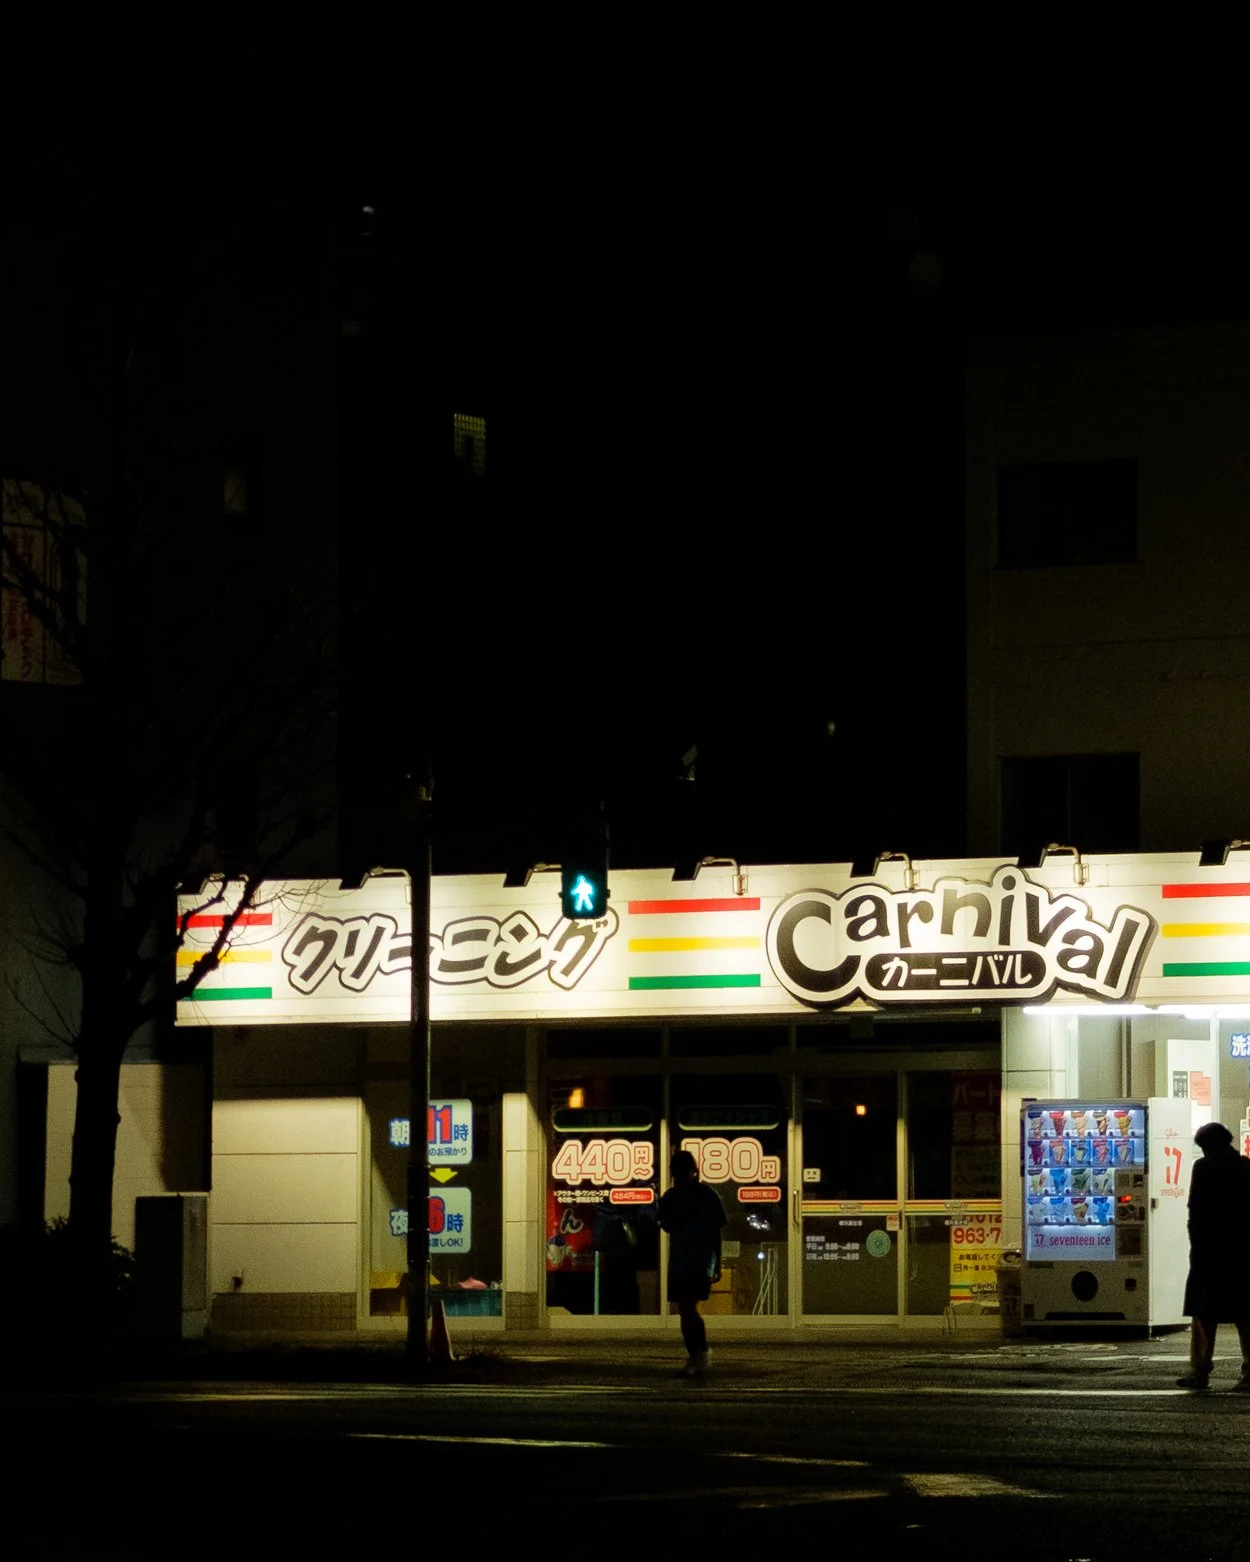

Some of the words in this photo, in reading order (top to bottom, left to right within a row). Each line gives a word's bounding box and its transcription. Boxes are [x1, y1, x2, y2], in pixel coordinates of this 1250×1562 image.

[770, 868, 1153, 997] Carnival
[282, 909, 620, 994] クリーニング
[880, 954, 1032, 988] カーニバル
[429, 1237, 464, 1248] 渡しOK!
[1049, 1233, 1095, 1246] seventeen
[1097, 1233, 1111, 1246] ice
